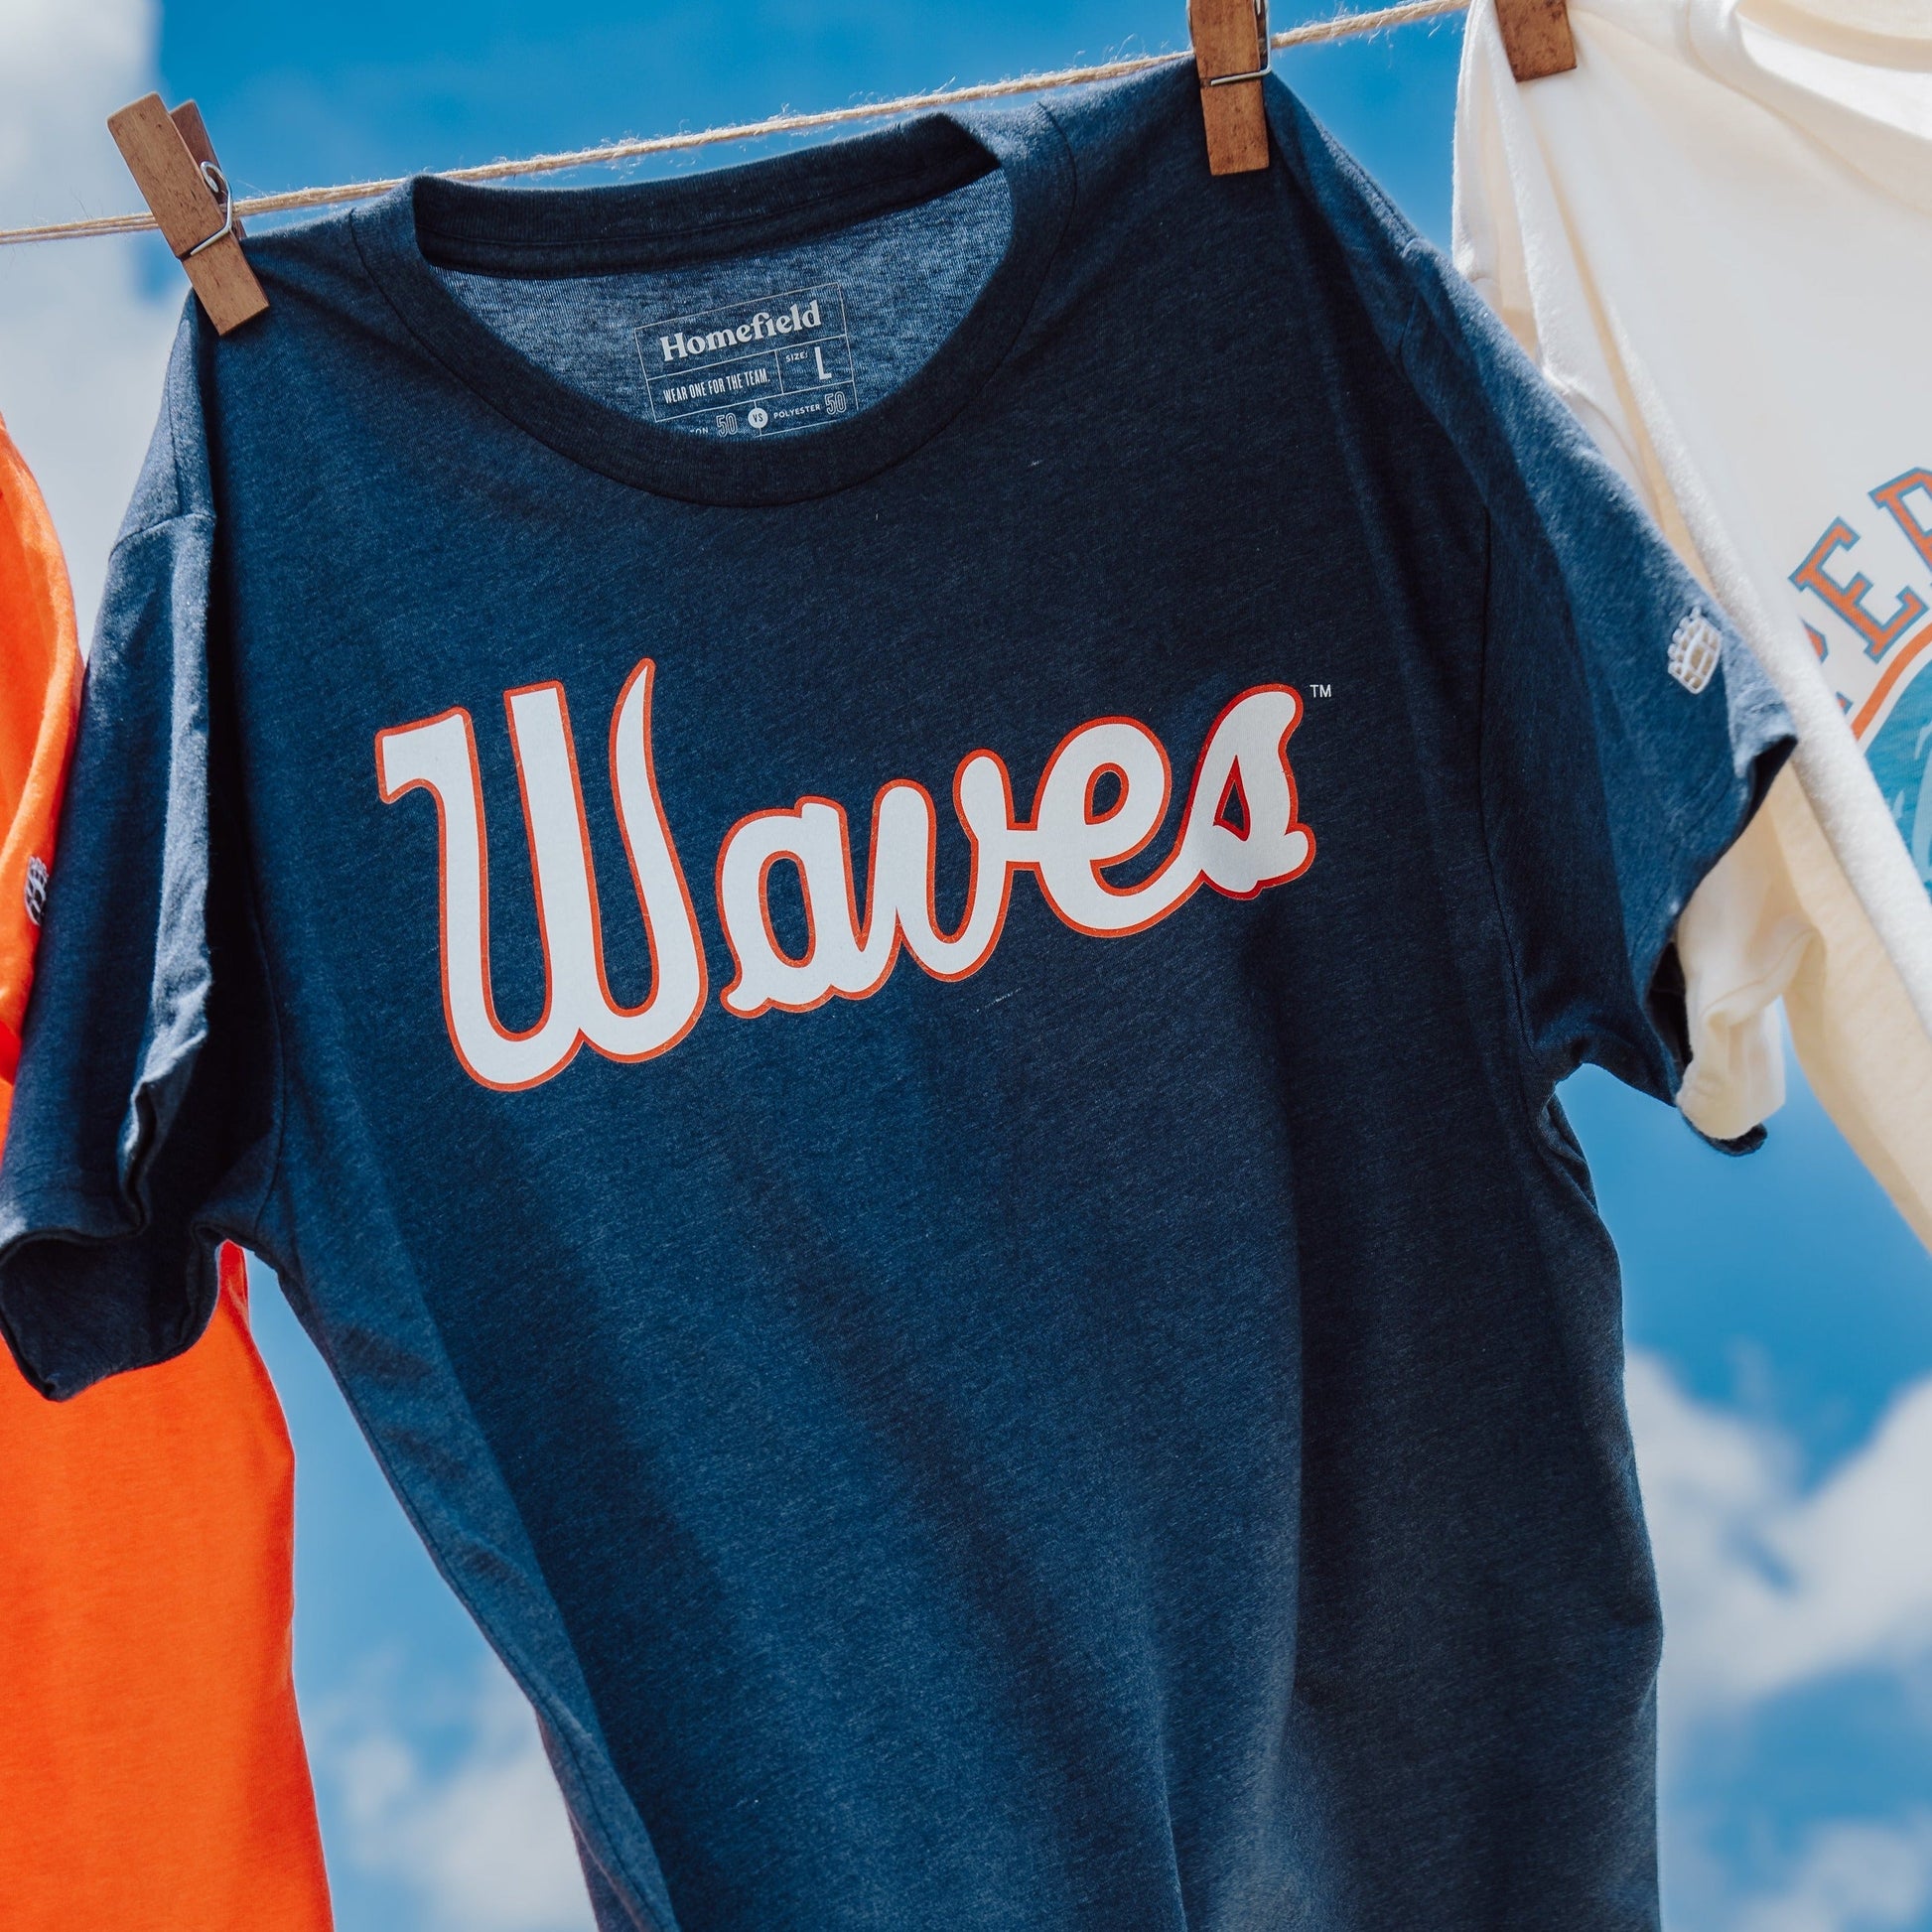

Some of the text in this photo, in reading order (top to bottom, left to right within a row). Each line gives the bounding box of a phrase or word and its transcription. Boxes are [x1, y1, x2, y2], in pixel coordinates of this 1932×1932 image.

[659, 300, 821, 361] Homefield
[814, 346, 833, 380] L
[663, 368, 770, 404] WEAR ONE FOR THE TEAM.
[753, 413, 763, 423] VS
[773, 391, 847, 419] POLYESTER 50
[716, 413, 738, 437] 50
[375, 658, 1315, 1092] Waves
